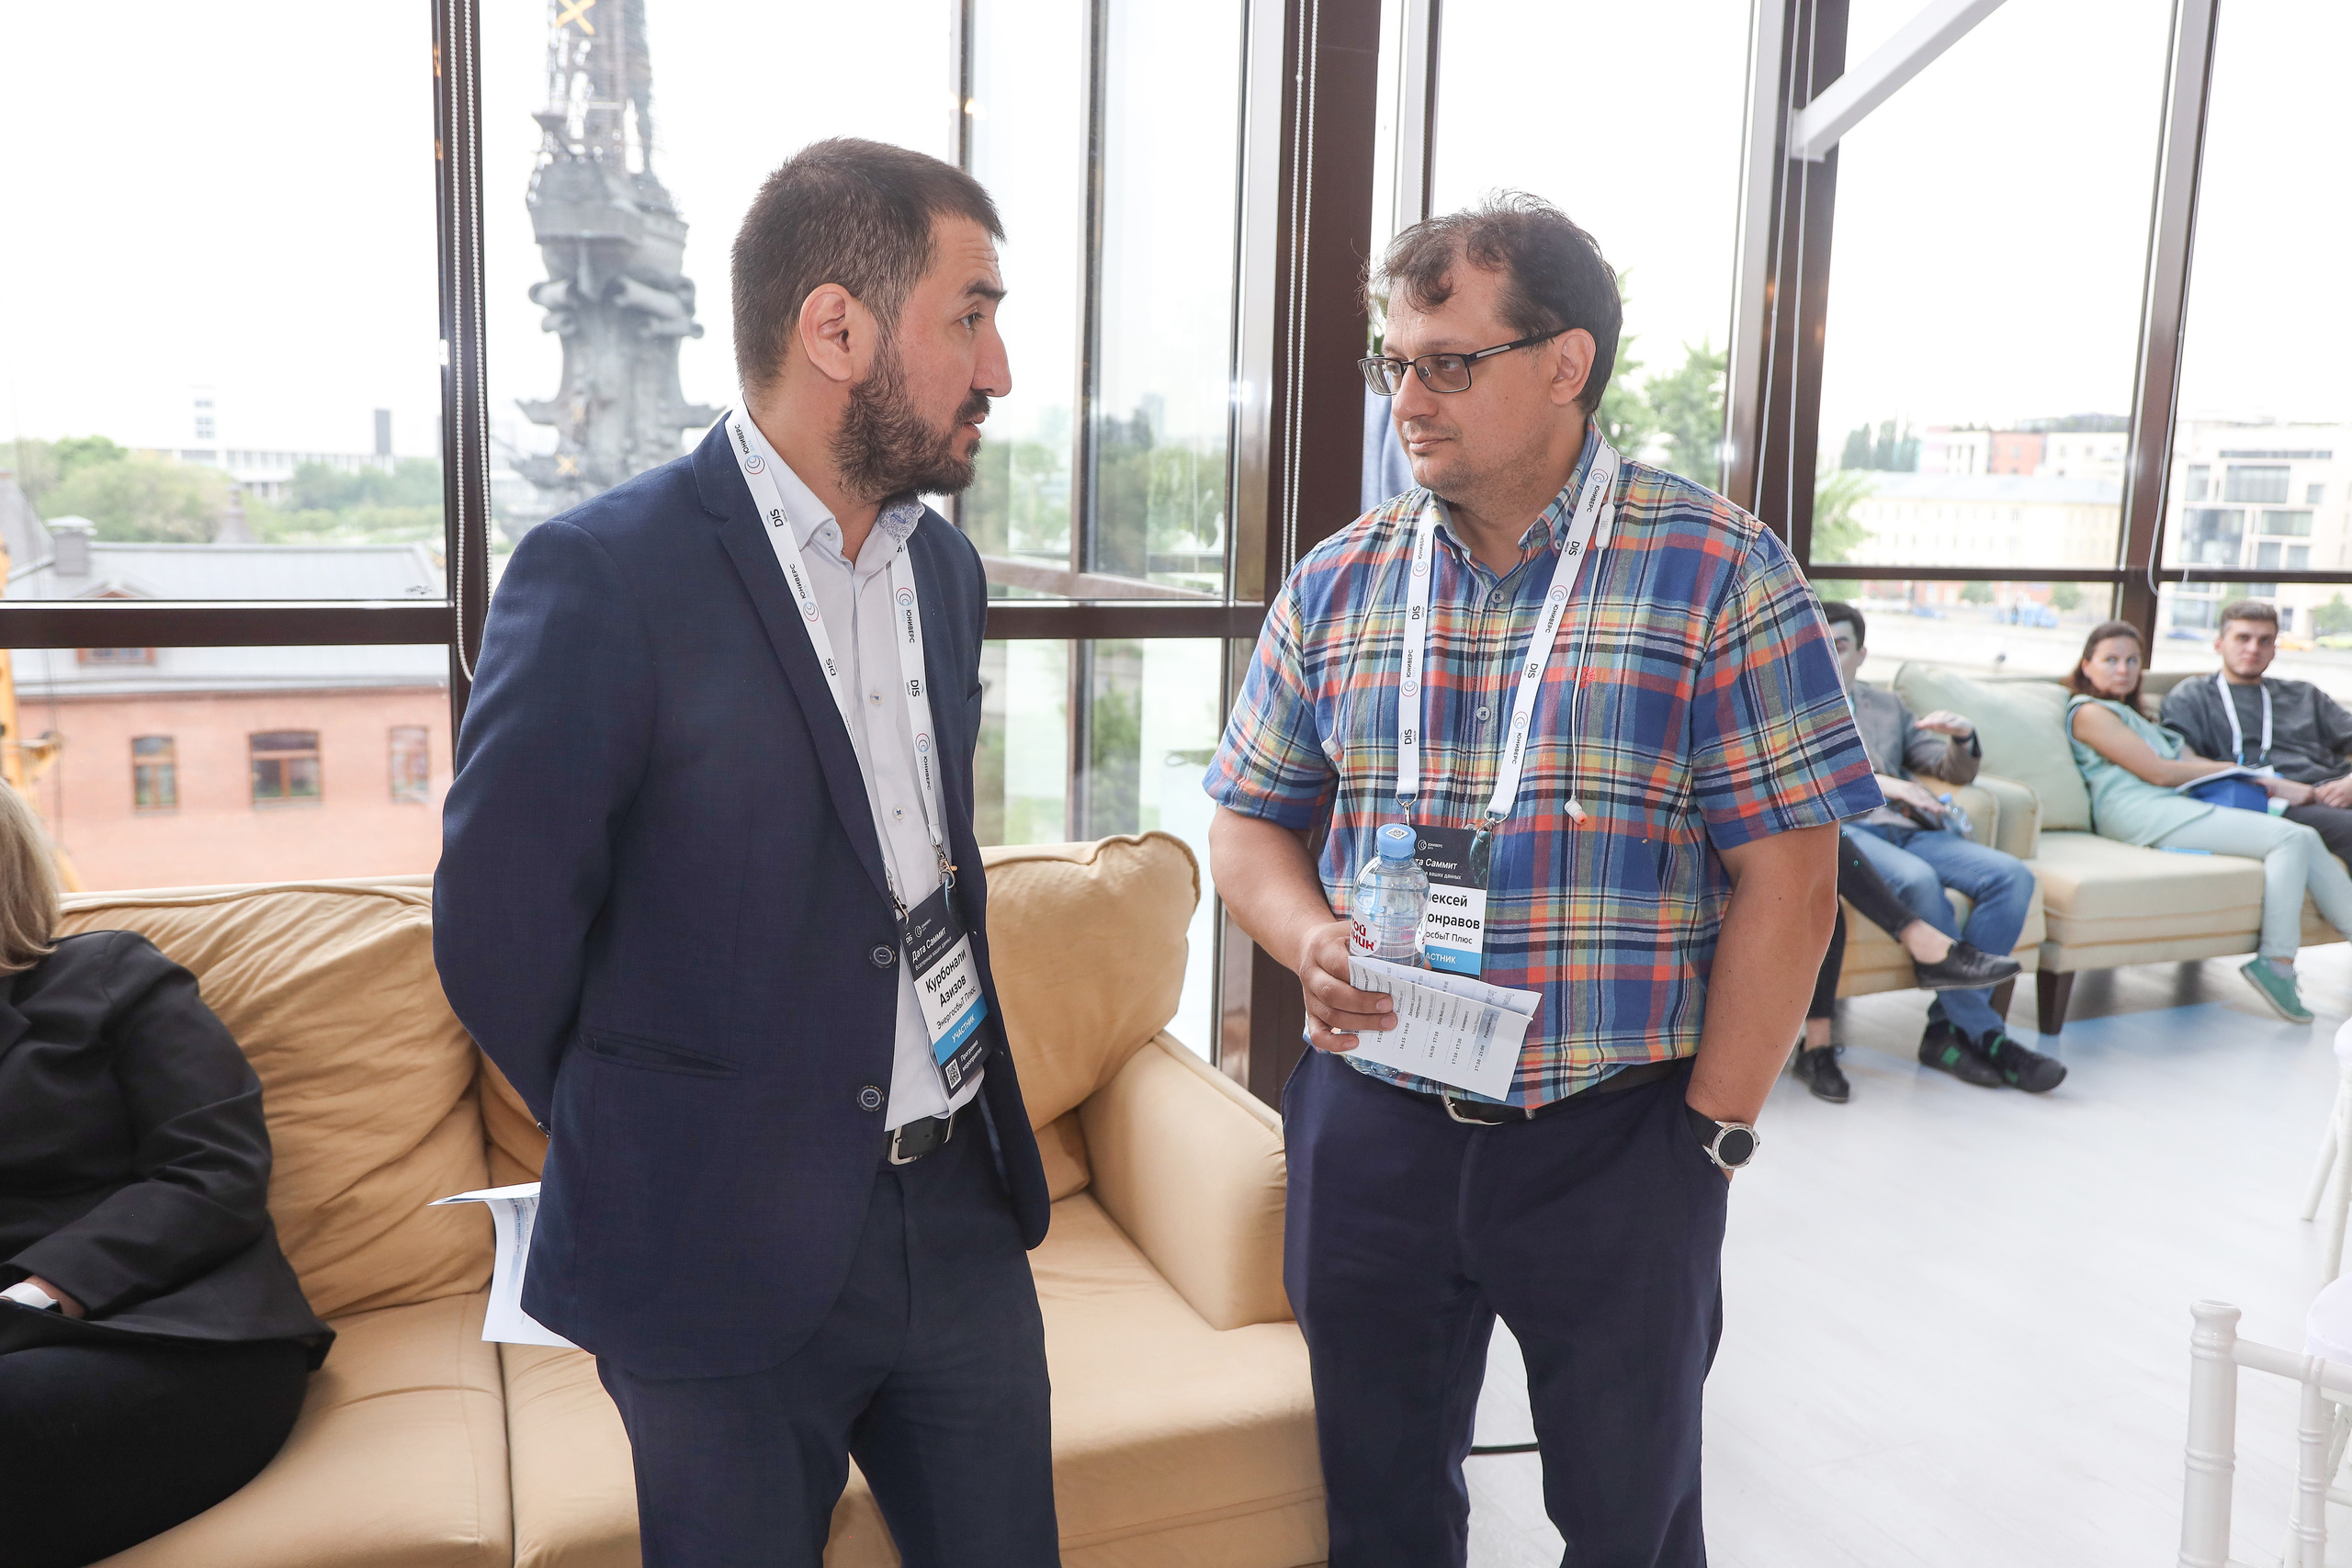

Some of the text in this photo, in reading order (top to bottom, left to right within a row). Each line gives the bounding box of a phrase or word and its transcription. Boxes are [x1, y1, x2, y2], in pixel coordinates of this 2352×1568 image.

[734, 423, 751, 455] ЮНИВЕРС
[1586, 485, 1600, 513] ЮНИВЕРС
[770, 508, 784, 528] DIS
[1568, 540, 1580, 557] DIS
[790, 563, 807, 600] ЮНИВЕРС
[1412, 605, 1420, 620] DIS
[1545, 604, 1559, 634] ЮНИВЕРС
[906, 609, 915, 644] ЮНИВЕРС
[825, 658, 837, 676] DIS
[1527, 662, 1539, 679] DIS
[910, 680, 920, 697] DIS
[1404, 728, 1412, 745] DIS
[1511, 732, 1522, 764] ЮНИВЕРС
[1415, 858, 1458, 870] та Саммит
[1430, 893, 1468, 908] ексей
[1428, 913, 1480, 930] онравов
[911, 926, 947, 964] Дата Саммит
[1351, 931, 1374, 952] НИК
[1426, 931, 1473, 944] осбыТ Плюс
[1425, 952, 1456, 964] АСТНИК
[925, 949, 967, 994] Курбонали
[939, 975, 967, 1008] Азизов
[964, 986, 977, 1002] Плюс
[951, 1013, 976, 1043] УЧАСТНИК
[960, 1040, 978, 1062] Программа
[962, 1046, 983, 1072] мероприятия
